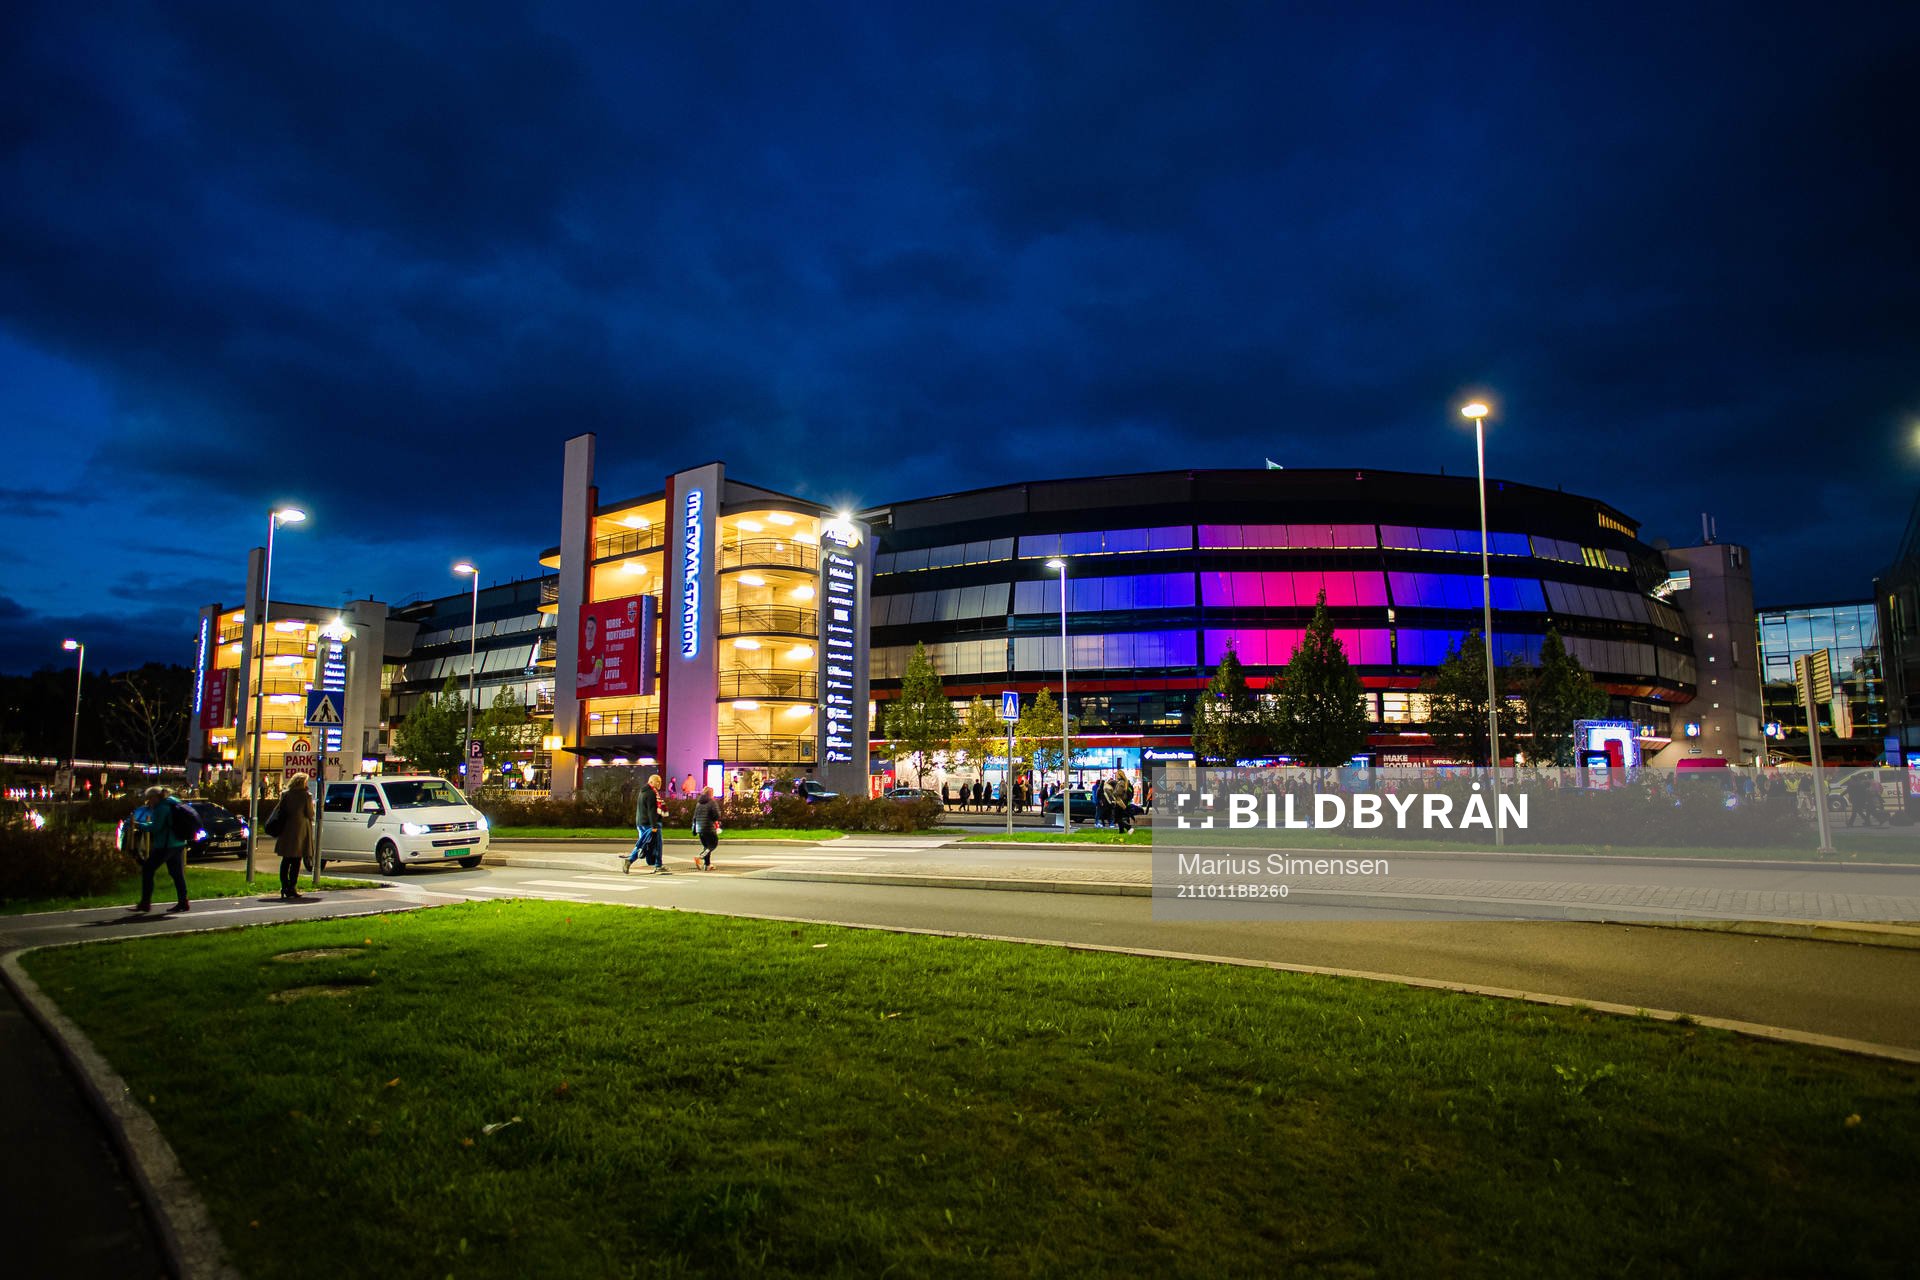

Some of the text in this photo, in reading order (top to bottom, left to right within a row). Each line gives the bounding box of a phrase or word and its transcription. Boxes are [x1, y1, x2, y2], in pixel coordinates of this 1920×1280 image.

[682, 491, 699, 656] ULLEVAAL STADION
[295, 743, 308, 752] 40
[285, 755, 316, 766] PARK-
[328, 757, 340, 765] KR
[1383, 754, 1408, 762] MAKE
